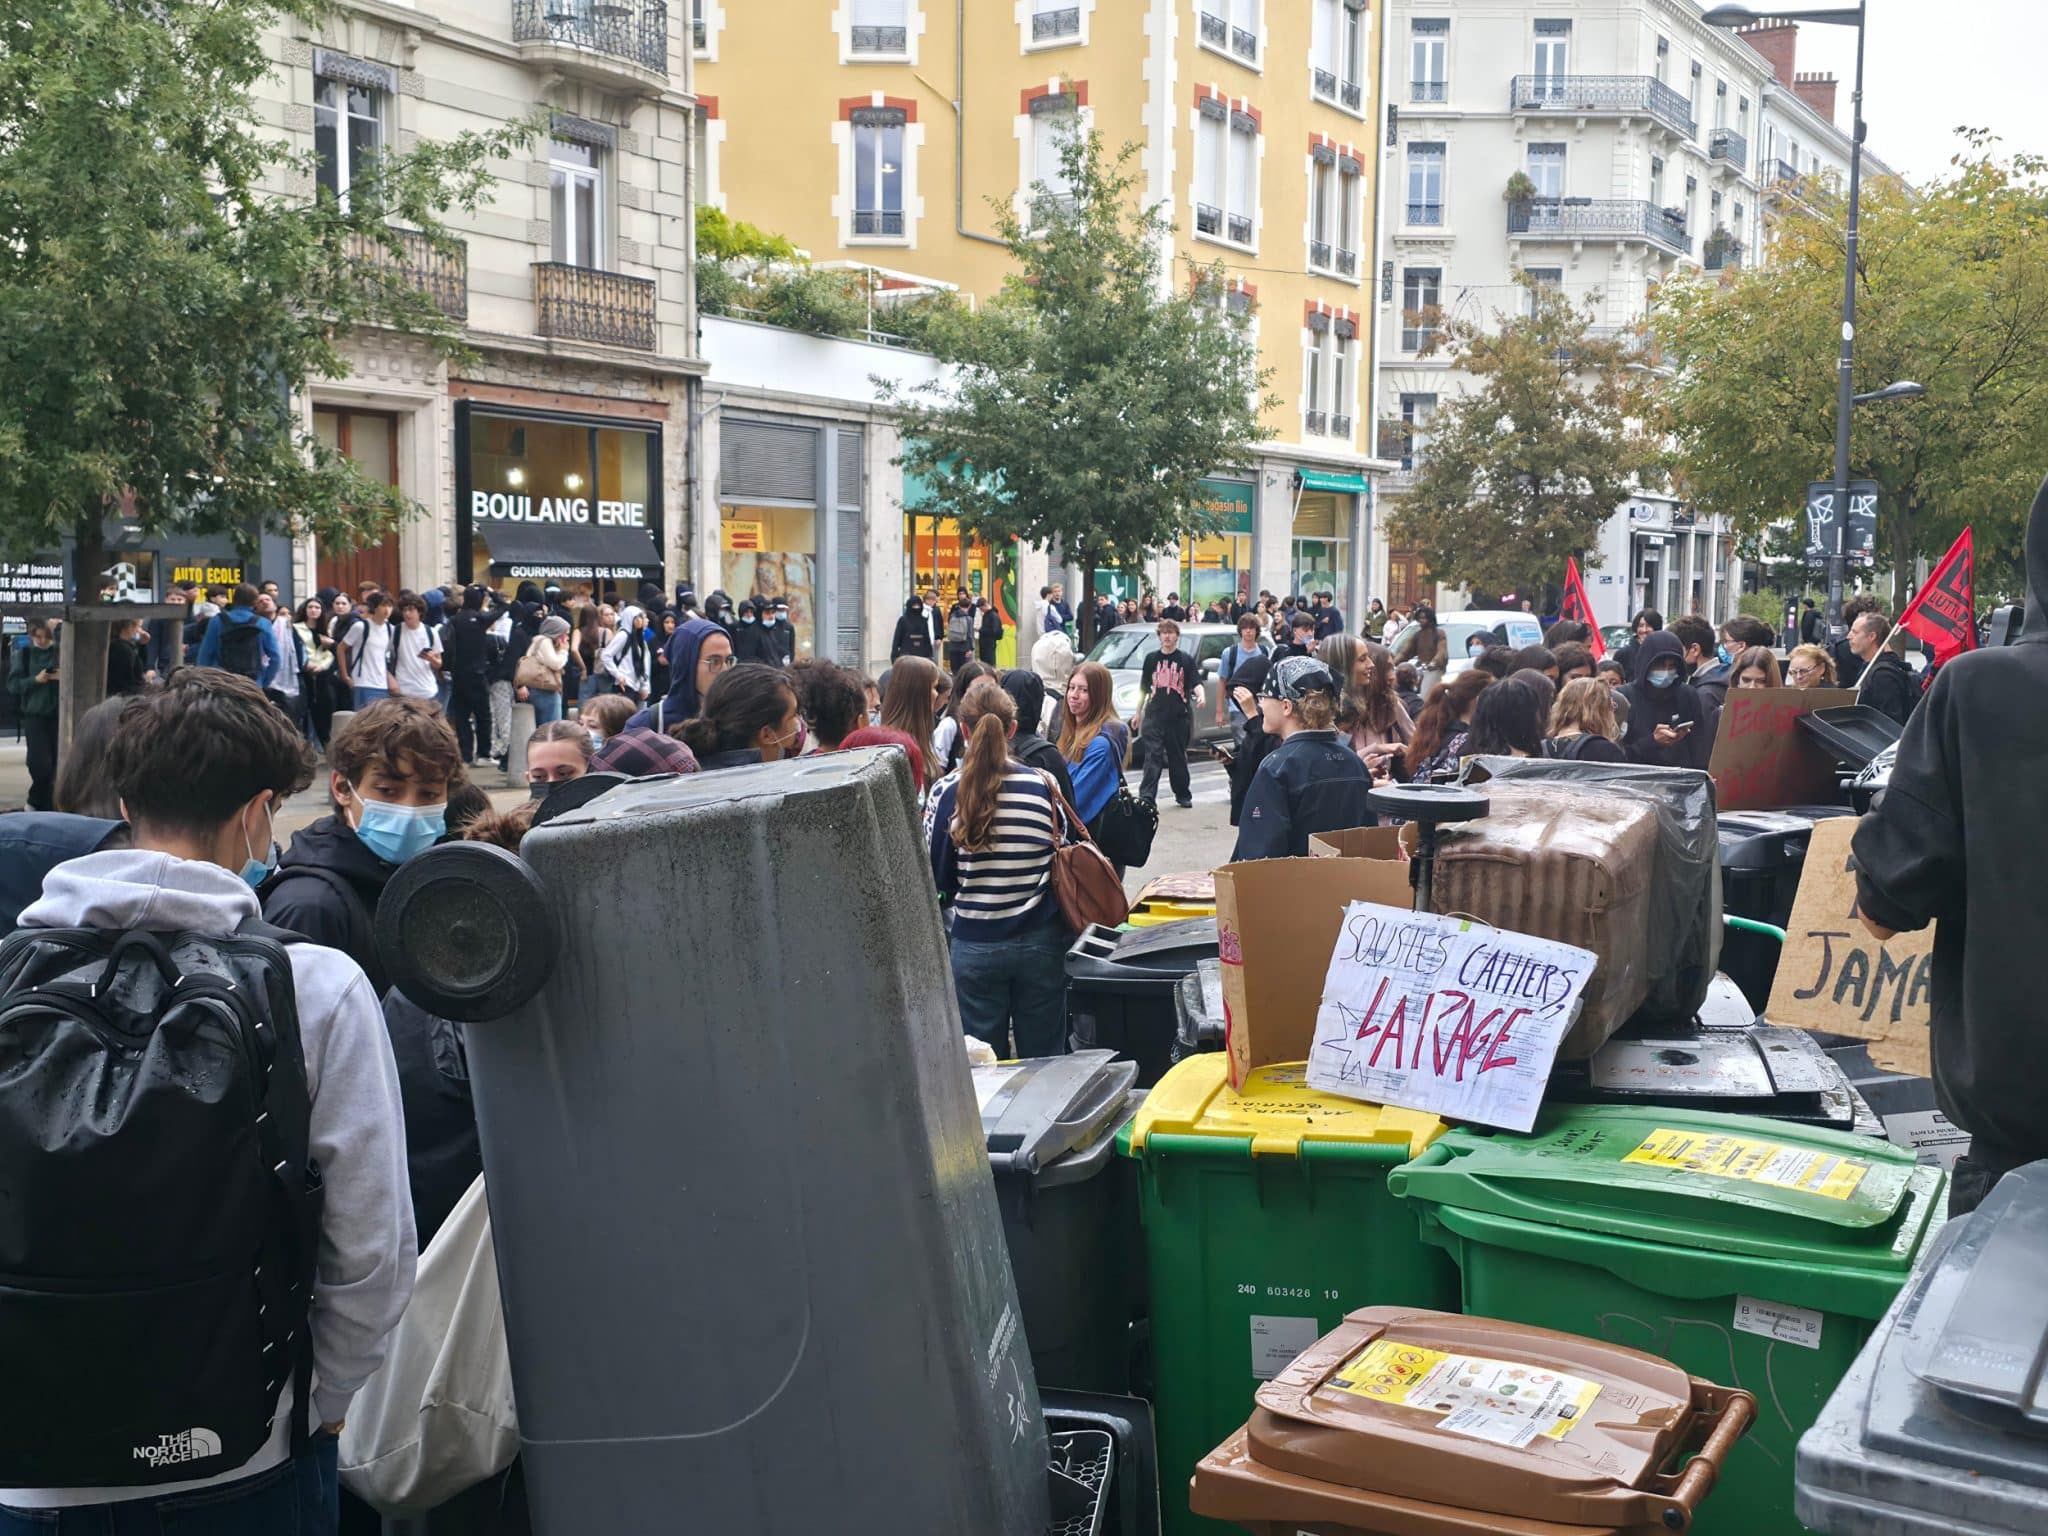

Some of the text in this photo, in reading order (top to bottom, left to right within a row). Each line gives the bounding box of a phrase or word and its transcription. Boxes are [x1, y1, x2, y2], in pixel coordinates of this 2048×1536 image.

[472, 491, 644, 526] BOULANG ERIE
[174, 567, 241, 584] AUTO ECOLE
[510, 566, 643, 578] GOURMANDISES DE LENZA
[18, 591, 32, 602] 125
[33, 592, 42, 602] et
[42, 592, 64, 602] MOTO
[1793, 931, 1933, 1024] JAMA
[1238, 1284, 1339, 1300] 240 603426 10
[158, 1429, 190, 1446] THE
[133, 1440, 191, 1459] NORTH
[150, 1450, 191, 1468] FACE
